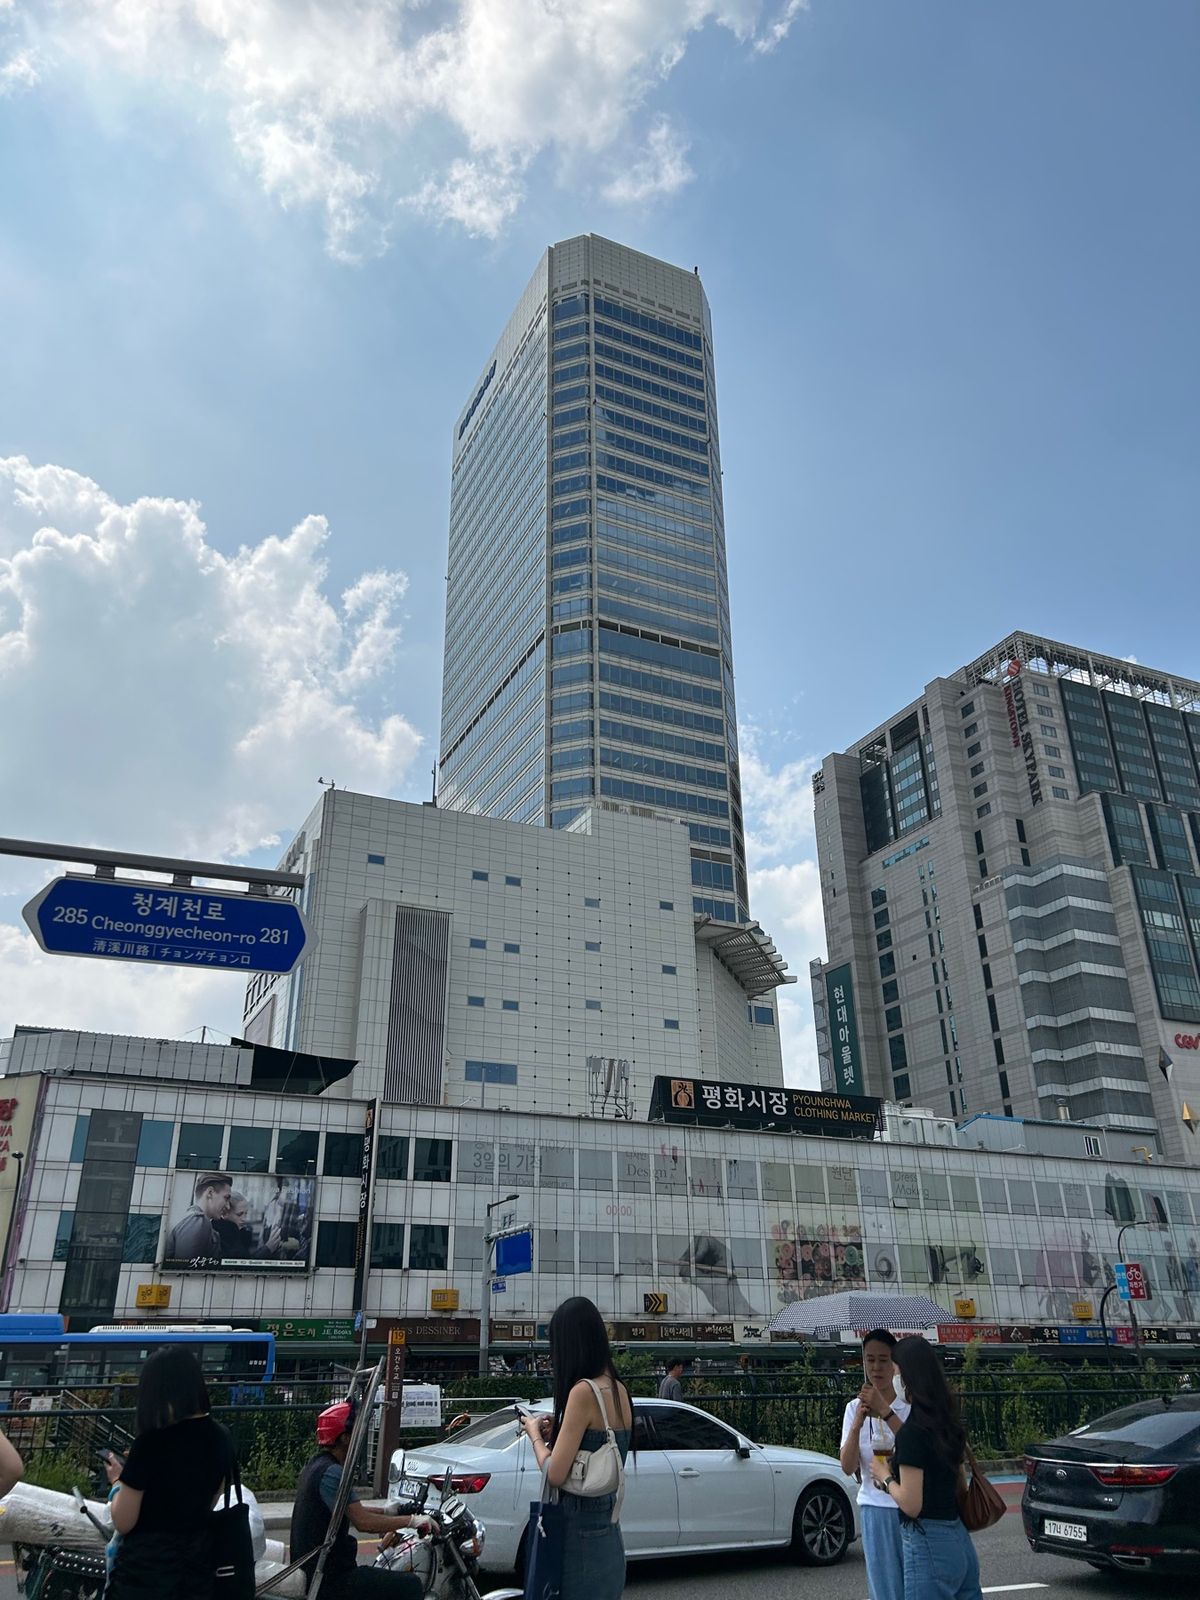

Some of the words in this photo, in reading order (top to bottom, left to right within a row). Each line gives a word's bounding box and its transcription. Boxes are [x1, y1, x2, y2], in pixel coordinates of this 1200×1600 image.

[1004, 684, 1021, 749] KINGSTOWN
[1012, 676, 1029, 733] HOTEL
[1021, 731, 1043, 807] SKYPARK
[52, 906, 89, 925] 285
[132, 892, 226, 921] 청계천로
[91, 915, 256, 945] Cheonggyecheon-ro
[259, 927, 289, 945] 281
[160, 947, 251, 965] チョンゲチョンロ
[833, 984, 855, 1086] 현대아울렛
[701, 1085, 789, 1116] 평화시장
[792, 1094, 852, 1109] PYOUNGHWA
[794, 1107, 839, 1120] CLOTHING
[841, 1112, 877, 1124] MARKET
[473, 1152, 510, 1171] 3일의
[627, 1163, 667, 1180] Desgn
[894, 1171, 918, 1182] Dress
[896, 1183, 929, 1199] Makg
[394, 1331, 404, 1341] 19
[416, 1326, 461, 1335] DESSINER
[1063, 1524, 1083, 1539] 6755
